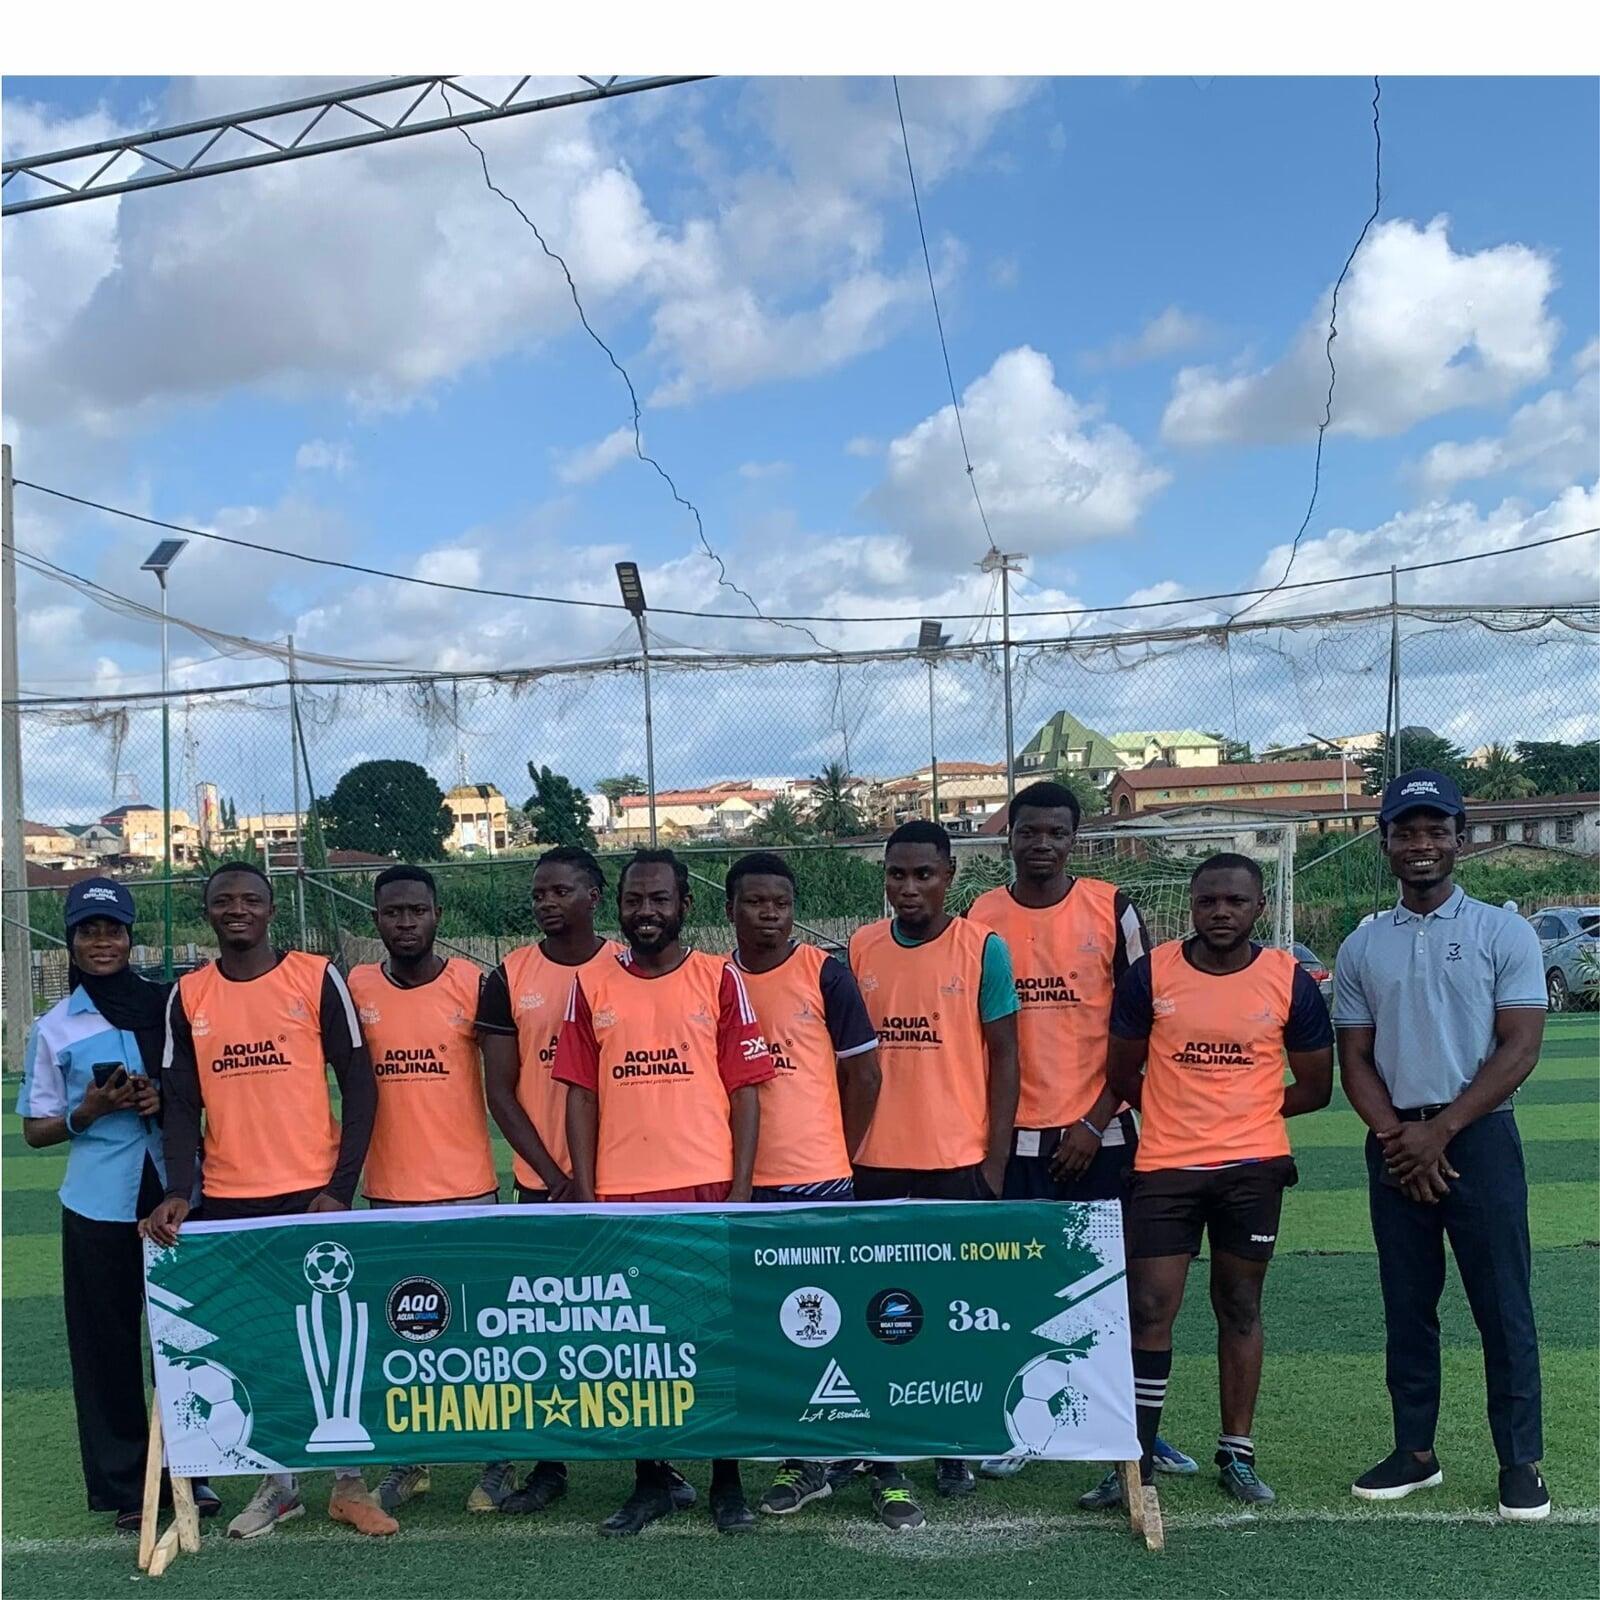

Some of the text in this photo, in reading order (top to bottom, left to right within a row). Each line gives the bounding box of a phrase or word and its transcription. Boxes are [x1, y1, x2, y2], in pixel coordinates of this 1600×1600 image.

[1015, 976, 1066, 990] AQUIA
[1018, 990, 1081, 1003] RIJINAL
[882, 1016, 930, 1030] AQUIA
[223, 1040, 276, 1056] AQUIA
[384, 1048, 436, 1061] AQUIA
[624, 1048, 678, 1063] AQUIA
[1184, 1041, 1242, 1054] AQUIA
[212, 1053, 292, 1073] ORIJINAL
[1172, 1052, 1254, 1065] ORIJINAL
[375, 1062, 450, 1076] ORIJINAL
[612, 1062, 694, 1079] ORIJINAL
[754, 1242, 1020, 1266] COMMUNITY. COMPETITION. CROWN
[507, 1273, 632, 1307] AQUIA
[397, 1294, 438, 1312] AQO
[476, 1304, 666, 1338] ORIJINAL
[948, 1299, 1011, 1332] 3a.
[382, 1342, 697, 1385] OSOGBO SOCIALS
[888, 1381, 984, 1407] DEEVIEW
[385, 1379, 695, 1433] CHAMPINSHIP
[828, 1408, 871, 1422] Essentials
